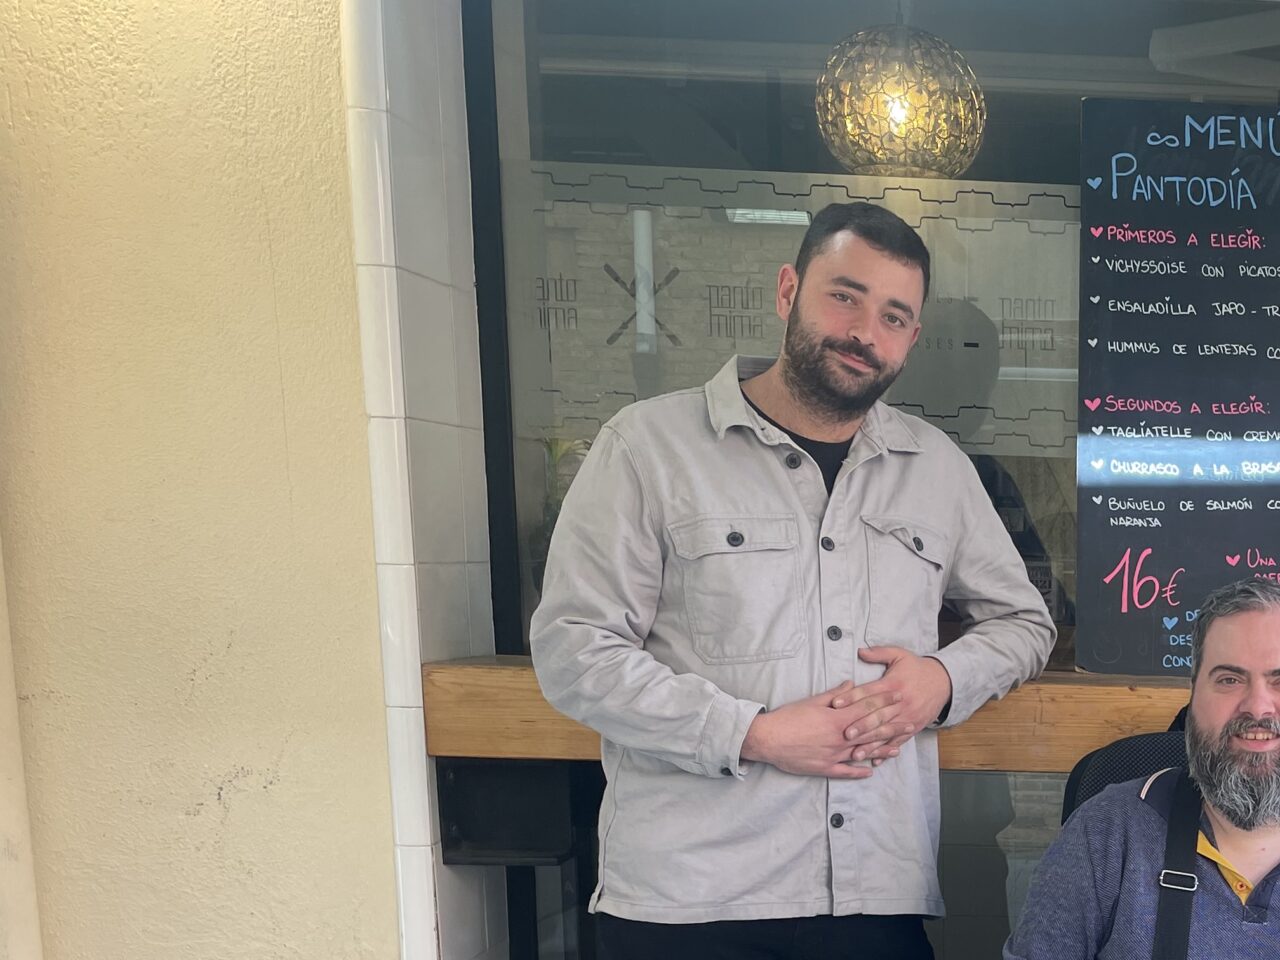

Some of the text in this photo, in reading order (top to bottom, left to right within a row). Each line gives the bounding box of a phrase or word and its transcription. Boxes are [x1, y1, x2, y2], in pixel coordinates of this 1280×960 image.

[1111, 152, 1257, 210] PANTODÍA
[1107, 223, 1266, 250] PRIMEROS A ELEGIR:
[1105, 254, 1187, 274] VICHYSSOISE
[1201, 263, 1224, 278] CON
[1108, 296, 1197, 315] ENSALADILLA
[1212, 302, 1245, 316] JAPO
[1107, 340, 1160, 355] HUMMUS
[1172, 343, 1187, 355] DE
[1198, 342, 1257, 356] LENTEJAS
[1104, 395, 1270, 415] SEGUNDOS A ELEGIR:
[1107, 420, 1192, 438] TAGLIATELLE
[1206, 428, 1232, 442] CON
[1110, 458, 1180, 476] CHURRASCO
[1193, 462, 1204, 475] A
[1213, 462, 1230, 475] LA
[1108, 497, 1165, 512] BUÑUELO
[1179, 500, 1195, 511] DE
[1206, 497, 1253, 511] SALMÓN
[1110, 516, 1162, 528] NARANJA
[1247, 548, 1276, 568] UNA
[1103, 547, 1186, 614] 16€
